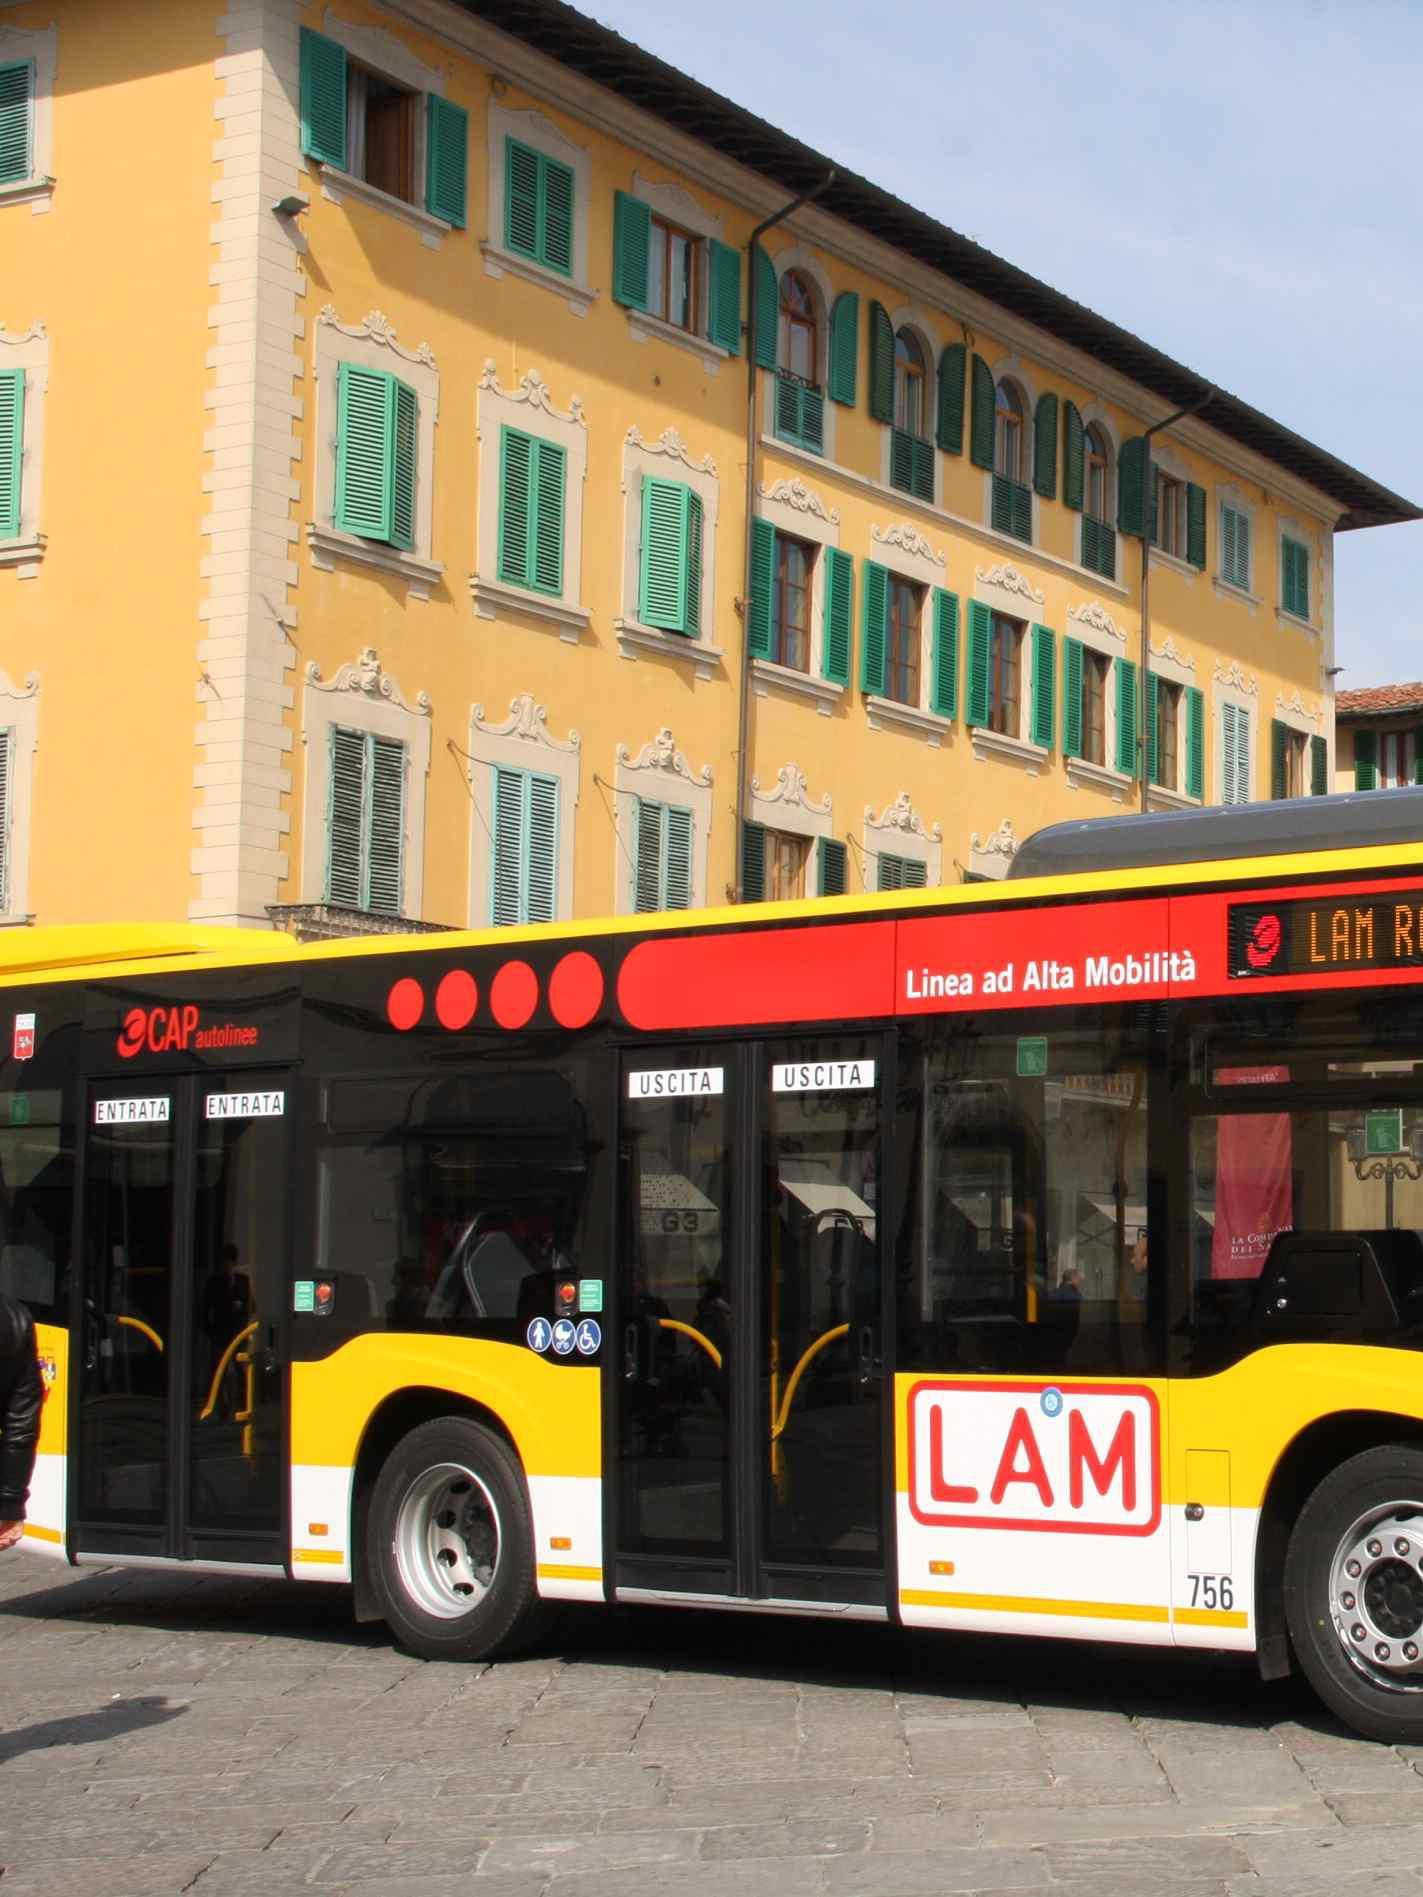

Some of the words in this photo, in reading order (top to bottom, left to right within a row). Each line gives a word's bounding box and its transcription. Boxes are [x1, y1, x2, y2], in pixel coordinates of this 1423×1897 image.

[1310, 907, 1373, 962] LAM
[906, 969, 974, 999] Linea
[982, 963, 1014, 994] ad
[1022, 961, 1075, 991] Alta
[1084, 950, 1197, 988] Mobilità
[150, 1005, 200, 1052] CAP
[195, 1025, 258, 1049] autolinee
[640, 1071, 712, 1095] USCITA
[784, 1063, 862, 1088] USCITA
[97, 1100, 167, 1121] ENTRATA
[208, 1093, 282, 1116] ENTRATA
[929, 1404, 1137, 1512] LAM
[1187, 1575, 1234, 1611] 756
